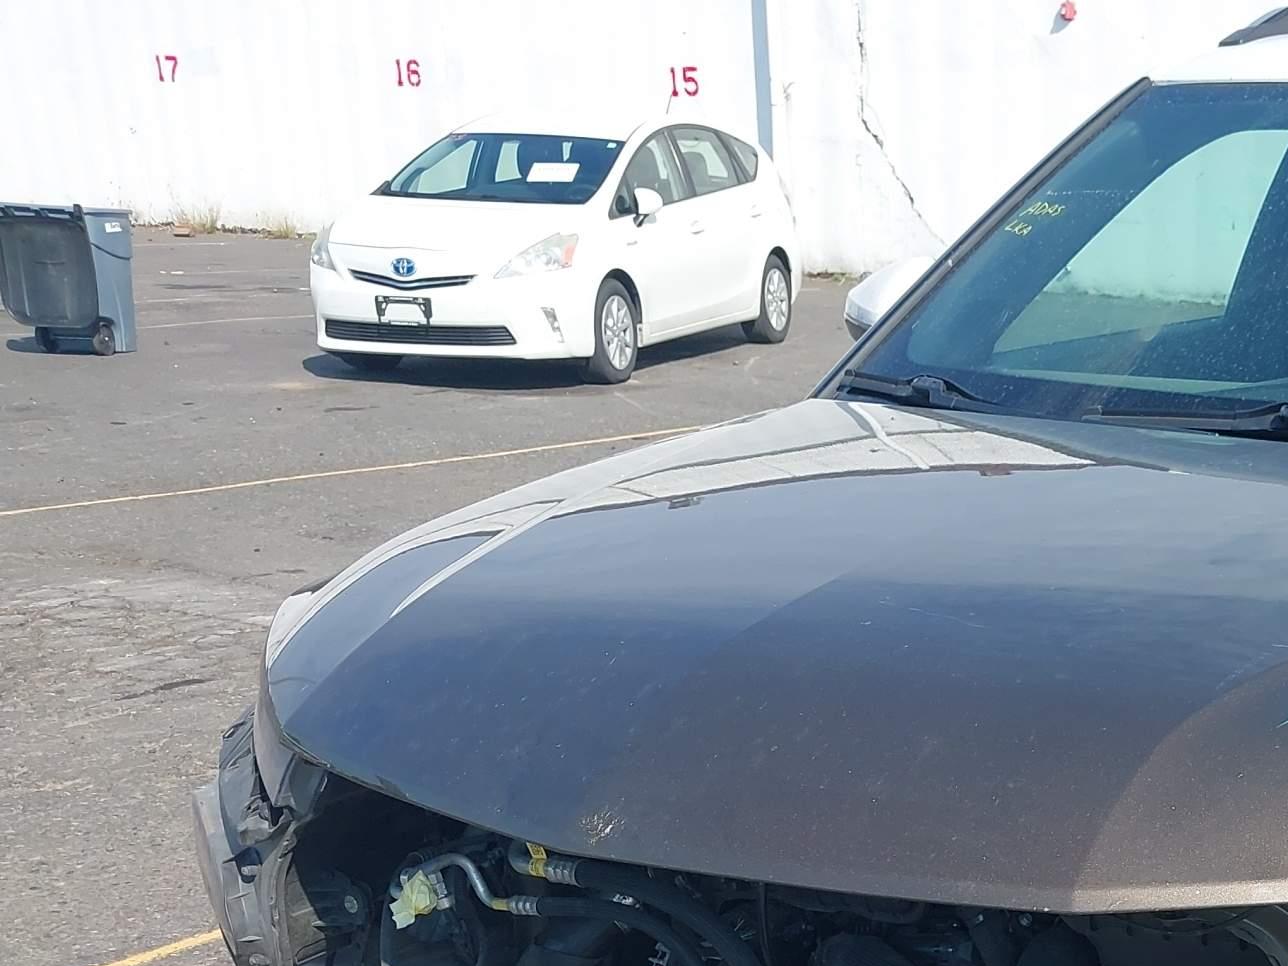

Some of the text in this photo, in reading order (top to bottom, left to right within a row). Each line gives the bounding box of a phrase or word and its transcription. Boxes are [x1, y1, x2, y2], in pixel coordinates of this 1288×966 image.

[155, 54, 178, 83] 17
[395, 59, 421, 87] 16
[670, 66, 700, 97] 15
